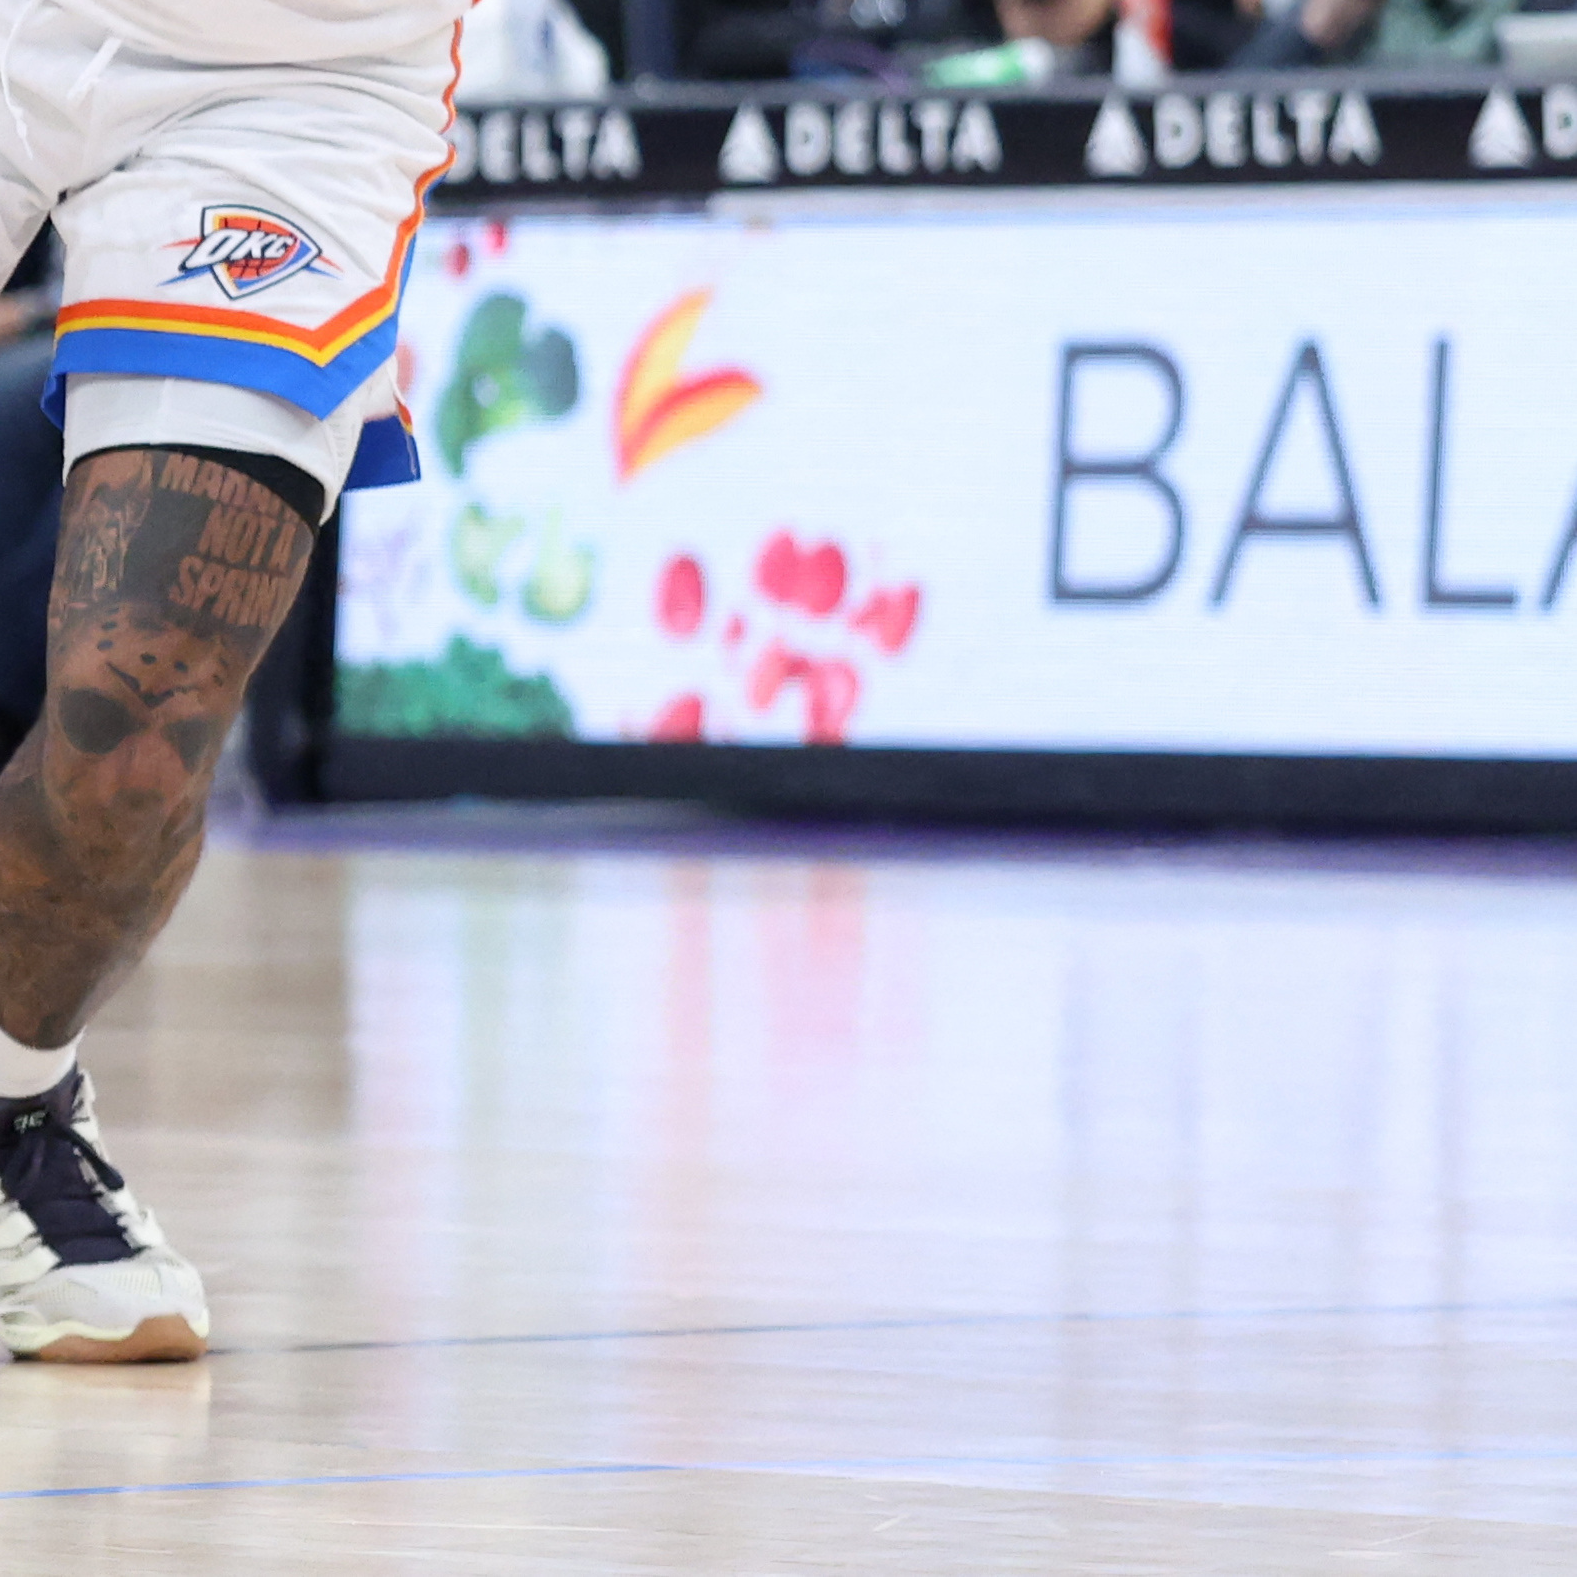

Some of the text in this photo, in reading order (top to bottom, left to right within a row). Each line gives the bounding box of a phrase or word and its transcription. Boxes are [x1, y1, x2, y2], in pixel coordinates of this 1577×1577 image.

[783, 100, 1003, 178] DELTA
[1153, 88, 1384, 170] DELTA
[179, 226, 295, 271] OKC
[168, 555, 279, 628] SPRIN
